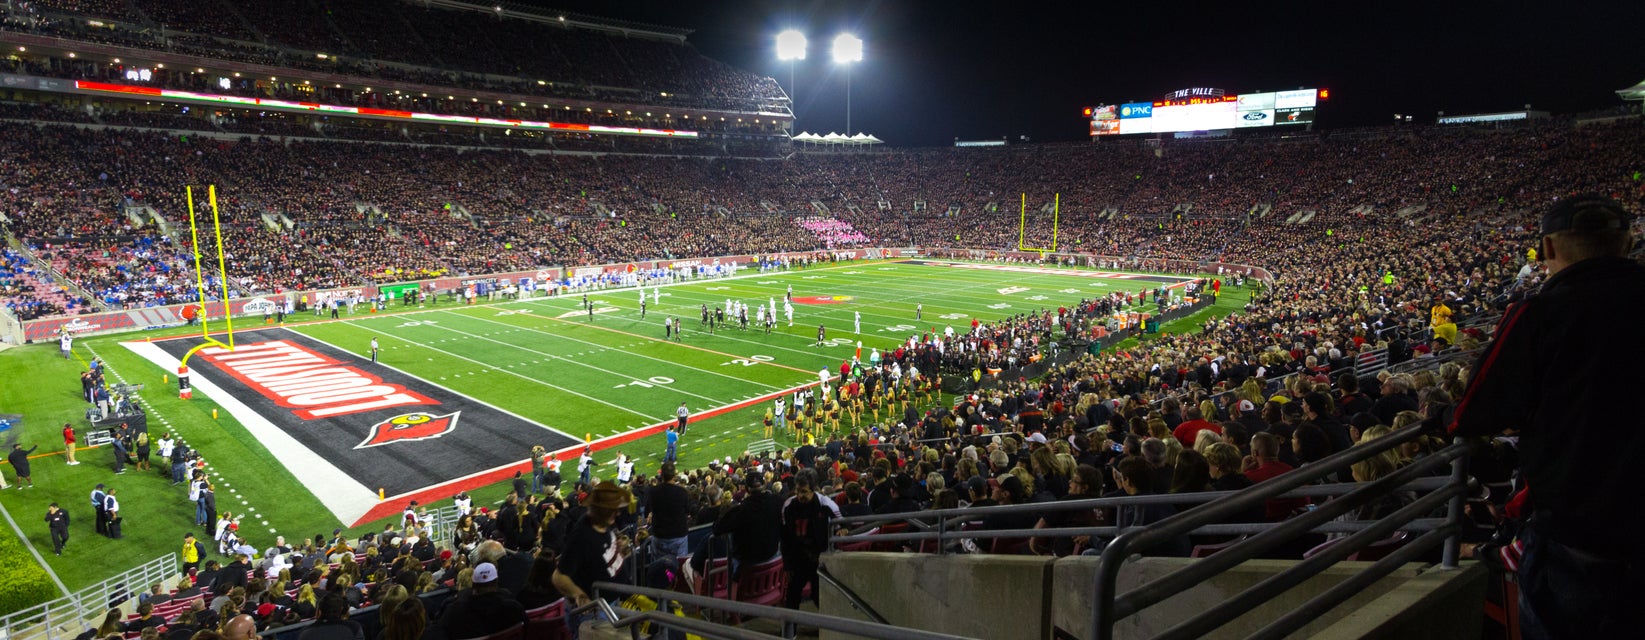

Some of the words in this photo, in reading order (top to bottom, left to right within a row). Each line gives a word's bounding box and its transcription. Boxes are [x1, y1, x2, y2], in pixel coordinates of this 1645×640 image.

[1175, 89, 1189, 98] THE
[1132, 106, 1152, 115] PNC
[732, 354, 774, 367] 20
[629, 376, 675, 388] 10
